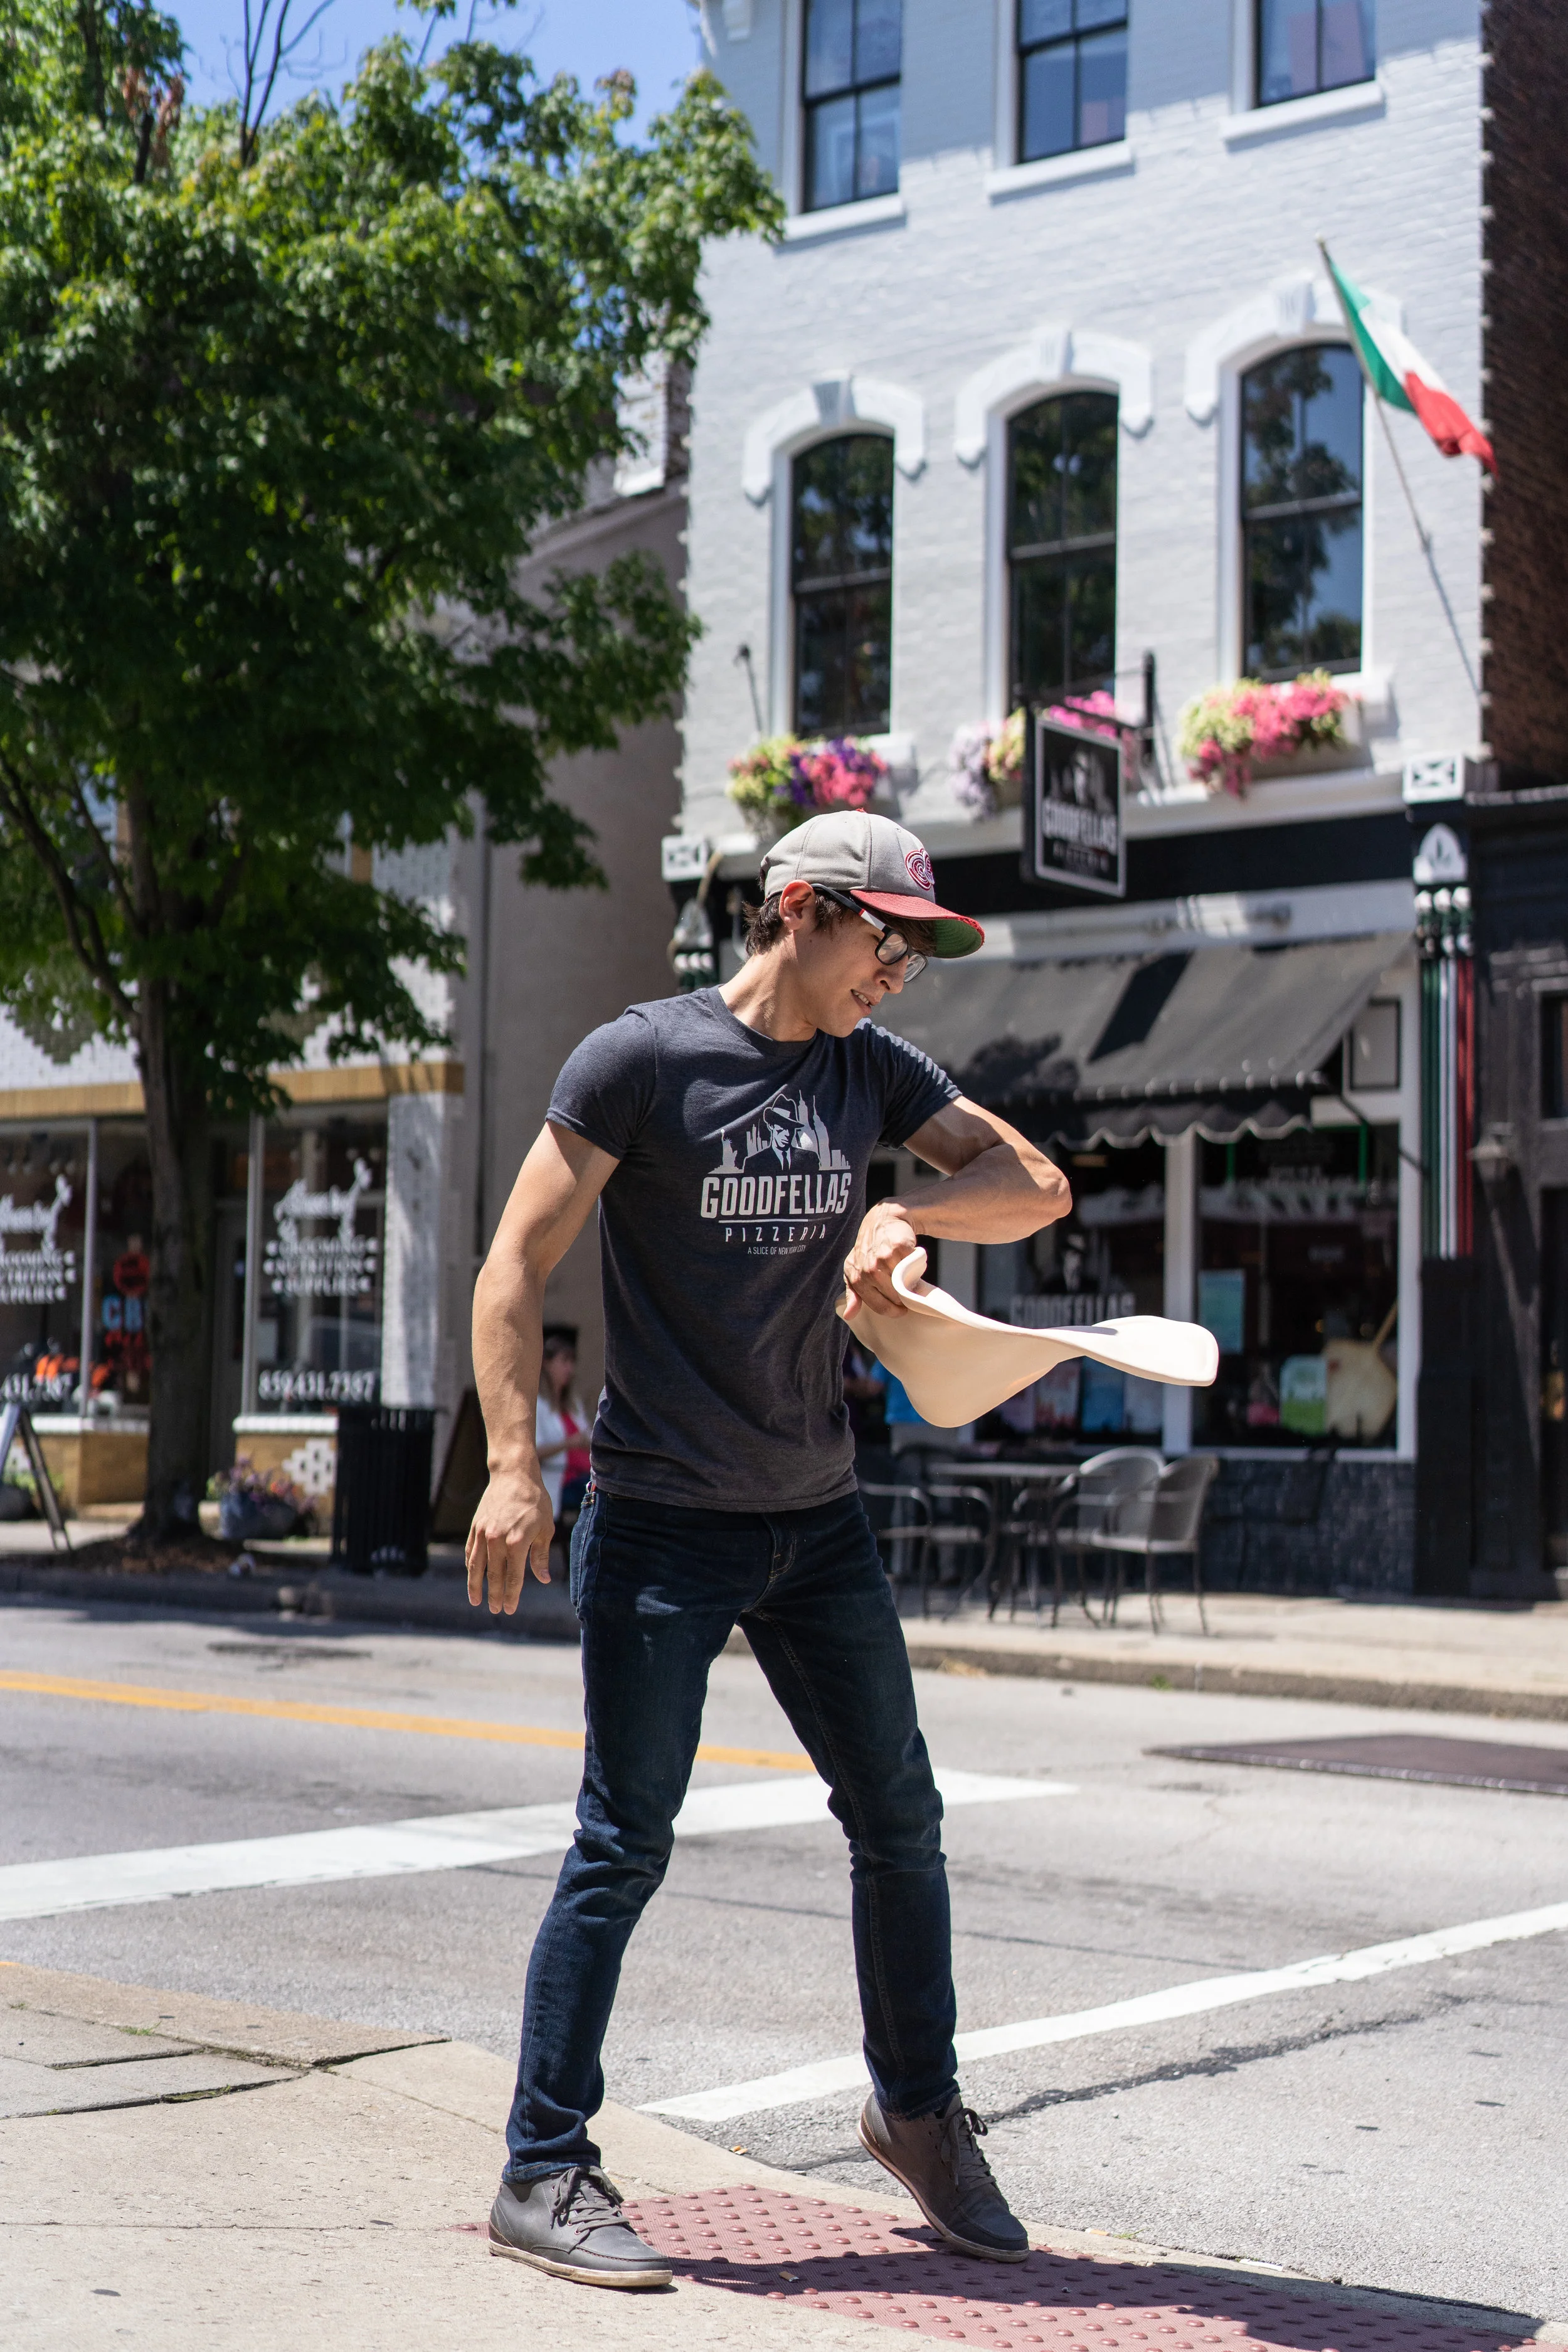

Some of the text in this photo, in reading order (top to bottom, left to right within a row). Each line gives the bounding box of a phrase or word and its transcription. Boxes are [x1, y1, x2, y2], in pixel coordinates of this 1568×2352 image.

[700, 1172, 852, 1219] GOODFELLAS
[725, 1224, 826, 1242] PIZZERIA
[753, 1246, 768, 1255] SLICE
[770, 1246, 778, 1255] OF
[778, 1247, 788, 1255] NEW
[788, 1246, 797, 1254] YORK
[797, 1244, 807, 1253] CITY
[1009, 1292, 1136, 1328] GOODFELLAS
